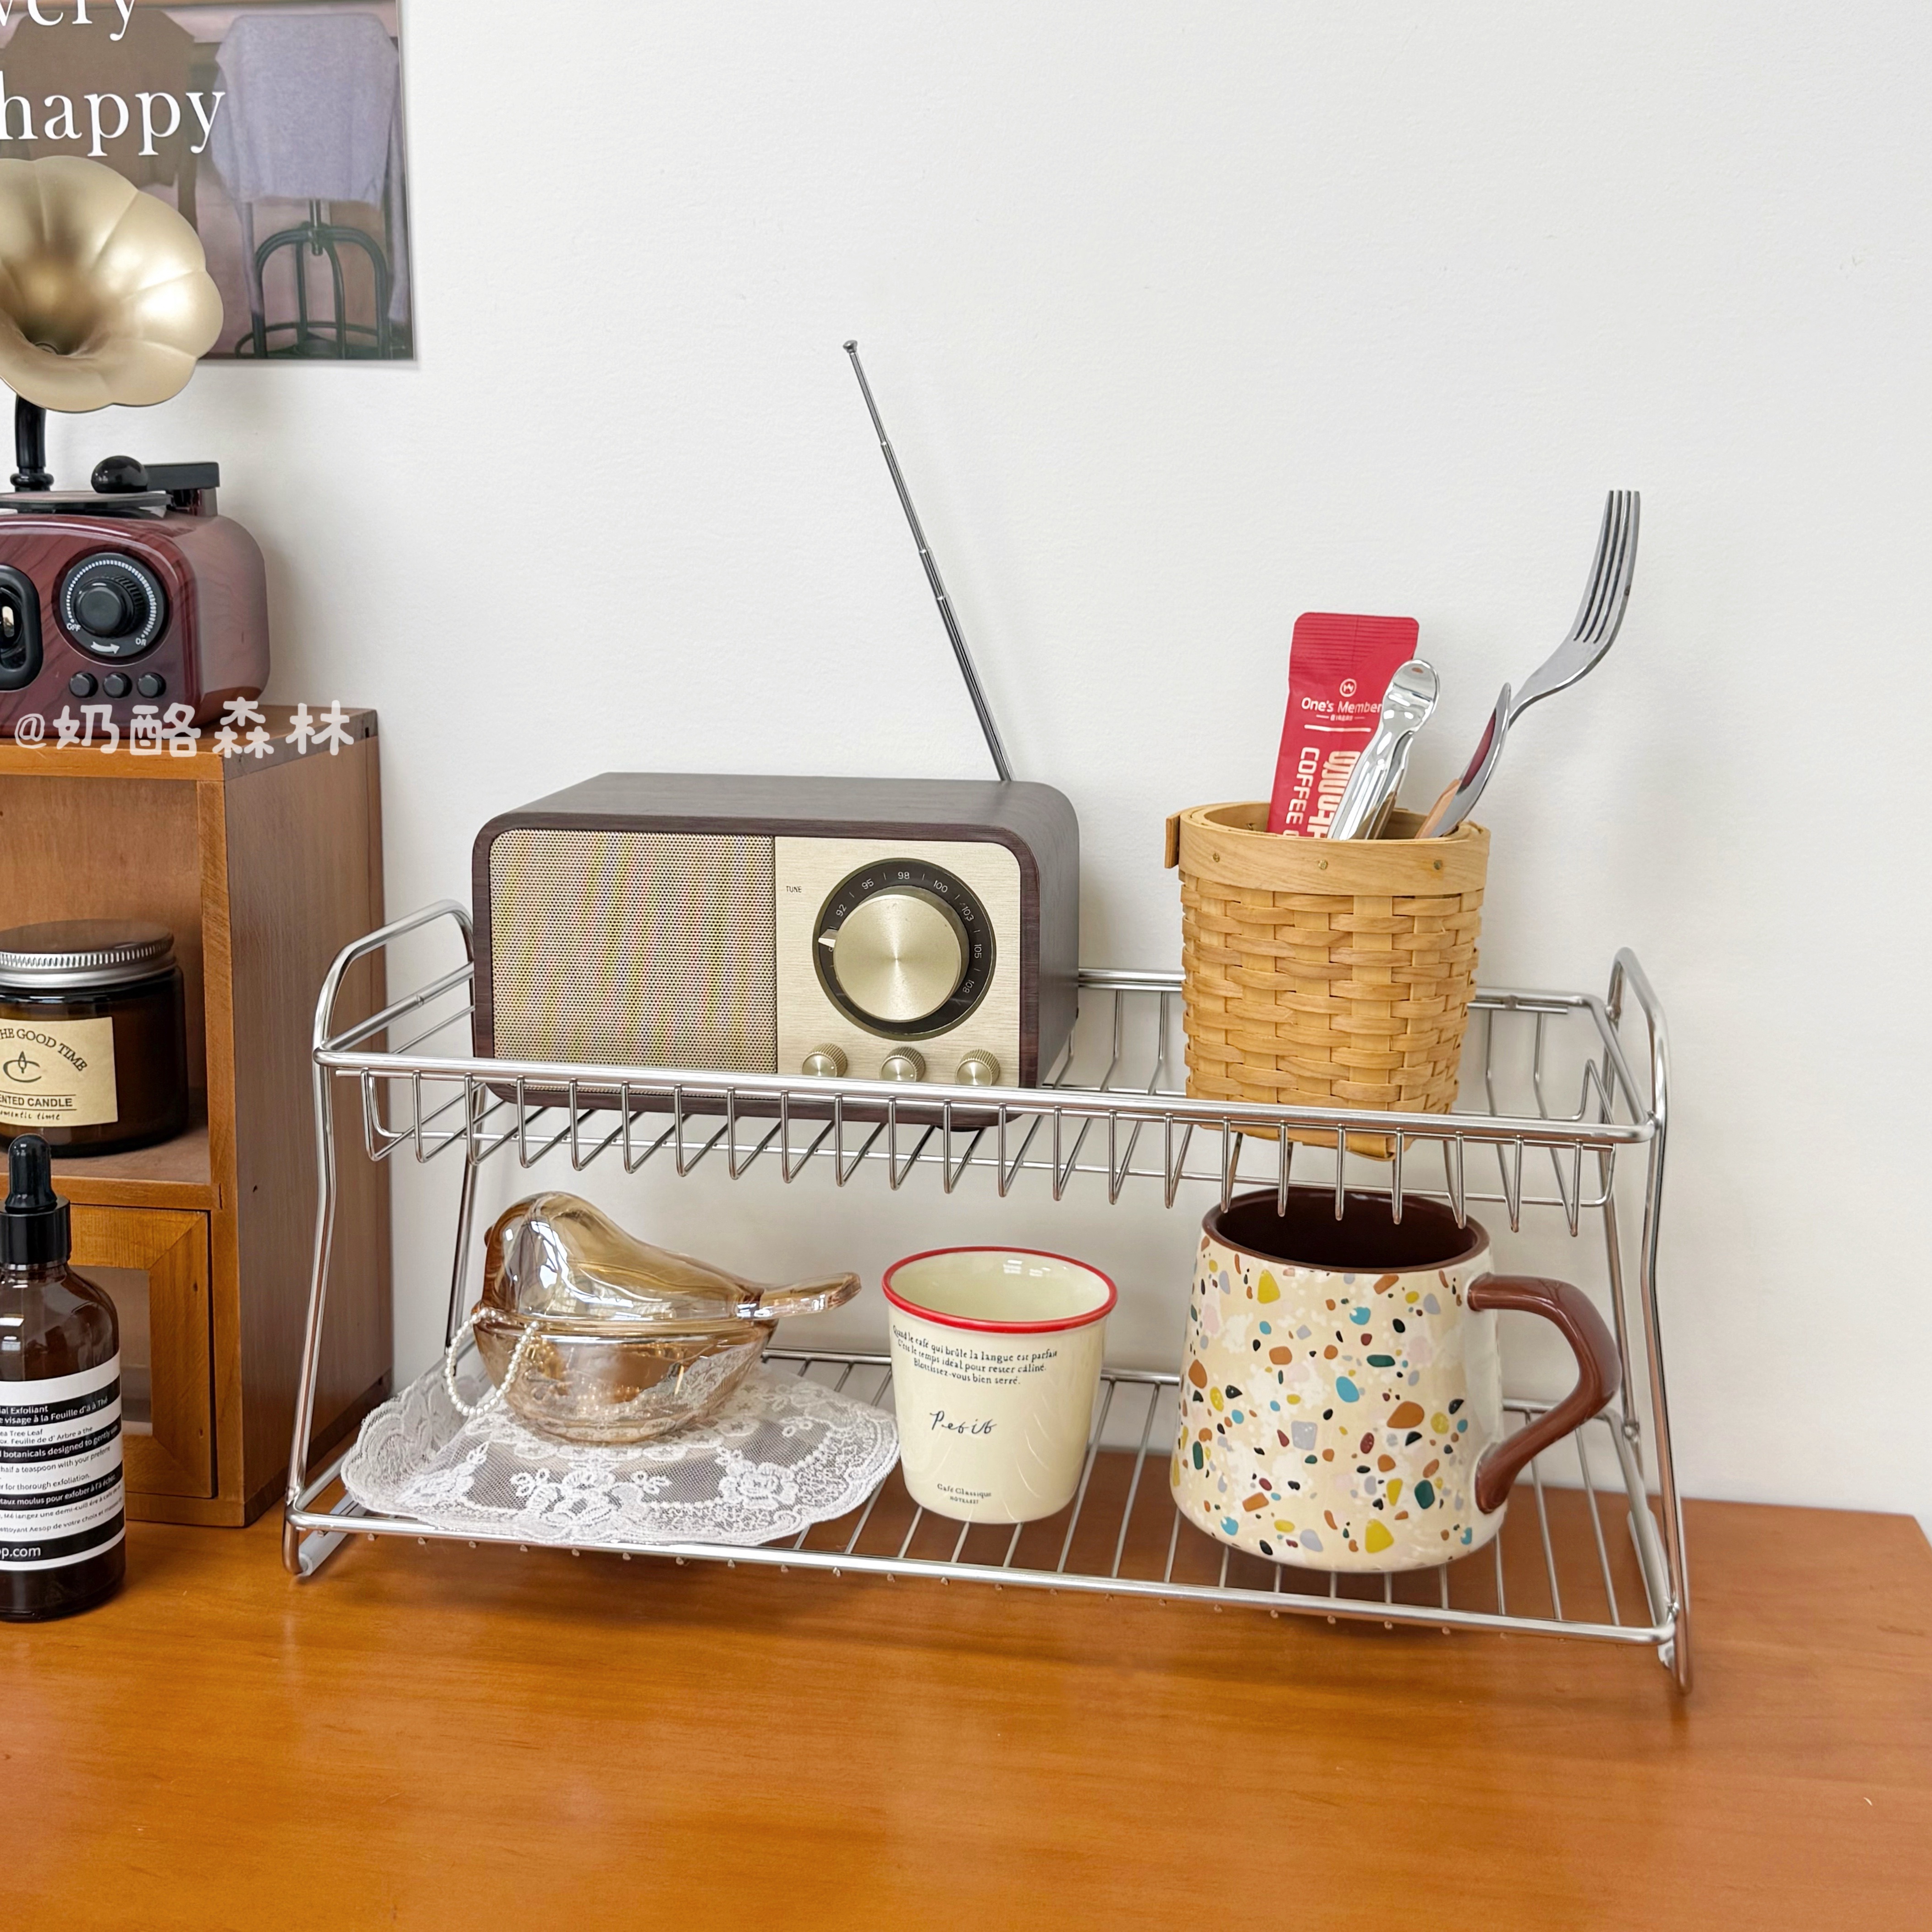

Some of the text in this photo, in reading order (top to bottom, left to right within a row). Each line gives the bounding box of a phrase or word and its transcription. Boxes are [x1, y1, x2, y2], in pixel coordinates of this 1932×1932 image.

[0, 71, 225, 157] happy
[66, 623, 81, 632] OFF
[1301, 697, 1334, 713] One's
[1286, 747, 1320, 825] COFFEE
[836, 871, 982, 994] 92 95 98 100 103 105 108
[17, 1029, 56, 1048] GOOD
[57, 1043, 88, 1072] TIME
[28, 1098, 73, 1107] CANDLE
[908, 1332, 914, 1343] le
[915, 1338, 929, 1348] café
[931, 1345, 943, 1354] qui
[946, 1346, 967, 1358] brûle
[970, 1349, 978, 1359] la
[981, 1351, 1013, 1364] langue
[942, 1358, 963, 1370] idéal
[965, 1363, 986, 1372] pour
[973, 1373, 991, 1384] bien
[5, 1416, 32, 1425] visage
[51, 1409, 78, 1420] Feuille
[11, 1405, 48, 1415] Exfoliant
[3, 1449, 46, 1458] botanicals
[48, 1440, 83, 1455] designed
[22, 1464, 56, 1473] teaspoon
[58, 1459, 73, 1469] with
[75, 1455, 89, 1466] your
[17, 1481, 51, 1490] thorough
[937, 1483, 954, 1493] Café
[46, 1495, 63, 1504] pour
[0, 1547, 41, 1559] p.com
